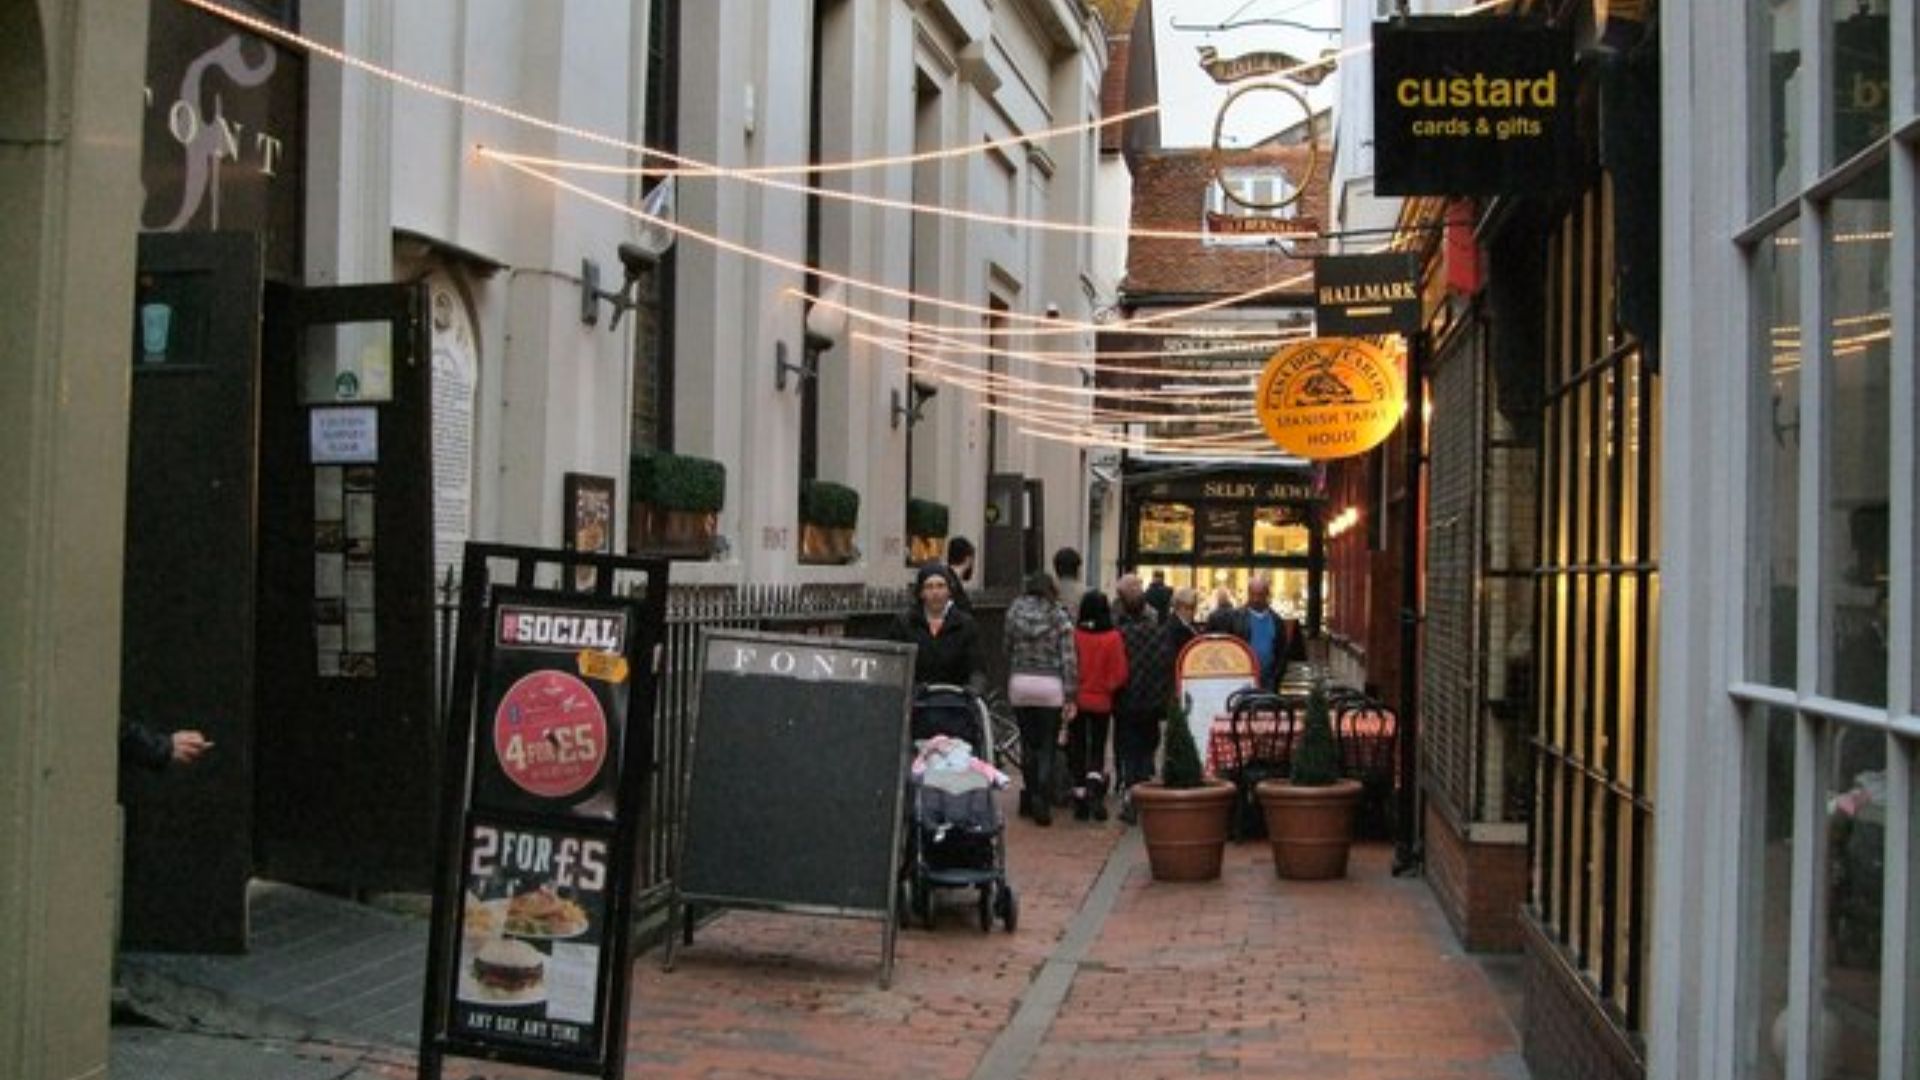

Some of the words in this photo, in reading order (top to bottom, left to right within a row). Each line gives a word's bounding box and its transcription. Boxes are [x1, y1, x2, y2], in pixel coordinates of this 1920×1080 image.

[1397, 69, 1556, 107] custard
[1412, 117, 1470, 136] cards
[1475, 117, 1489, 135] &
[1496, 116, 1541, 140] gifts
[1320, 282, 1417, 305] HALLMARK
[1276, 411, 1339, 428] SPANISH
[1307, 431, 1357, 445] HOUSE
[1204, 482, 1258, 498] SELBY
[518, 613, 617, 647] SOCIAL
[733, 647, 878, 681] FONT
[470, 826, 499, 876] 2
[501, 830, 552, 873] FOR
[554, 837, 608, 891] £5
[467, 1011, 494, 1029] ANY
[521, 1019, 548, 1038] ANY
[552, 1022, 580, 1042] TIME
